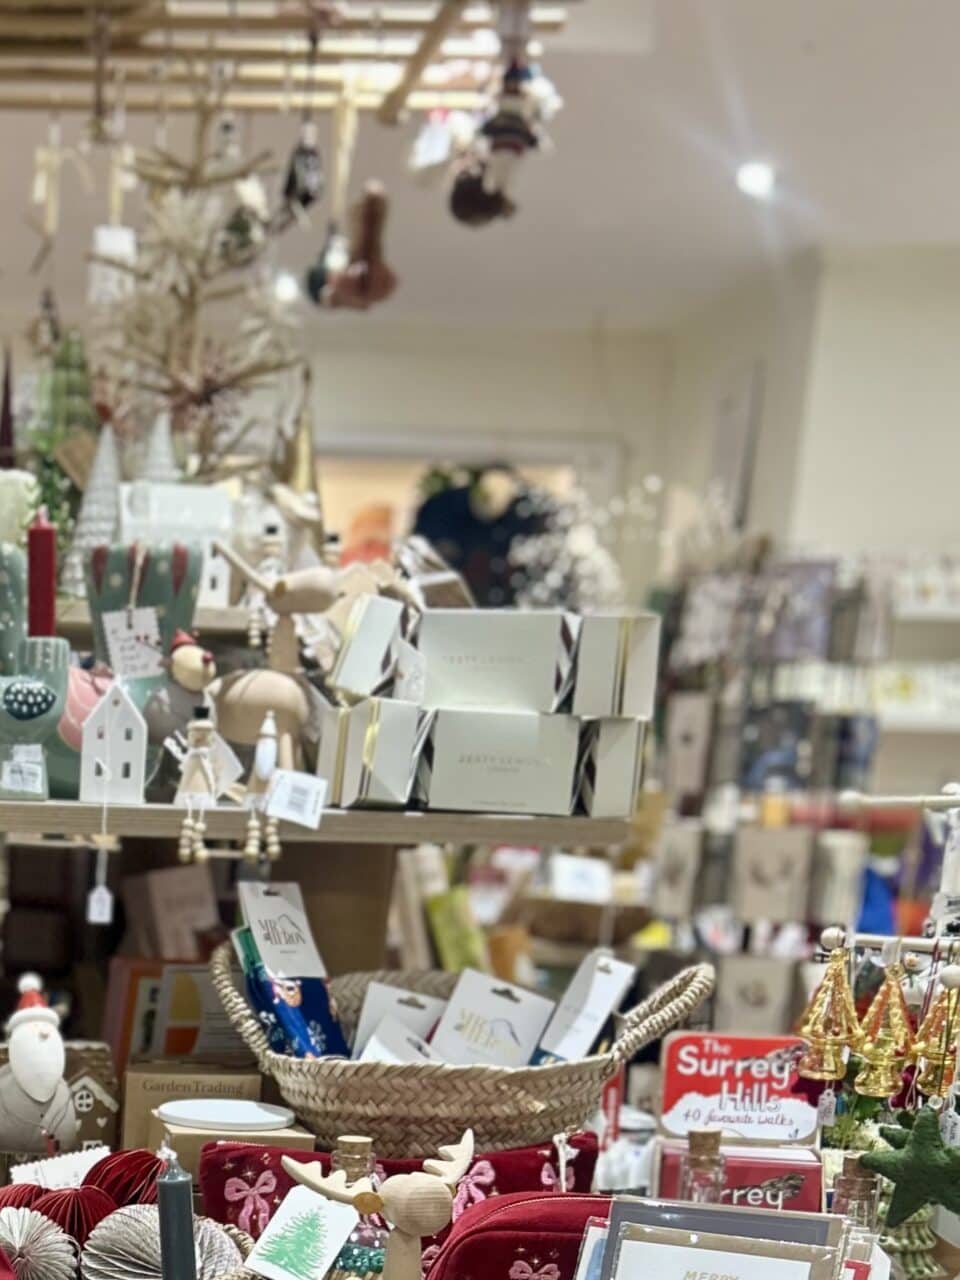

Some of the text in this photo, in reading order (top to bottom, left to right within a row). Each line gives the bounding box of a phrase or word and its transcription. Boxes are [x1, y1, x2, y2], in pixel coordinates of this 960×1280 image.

[702, 1038, 732, 1055] The
[676, 1044, 791, 1091] Surrey
[143, 1081, 244, 1096] Garden Trading
[718, 1080, 781, 1115] Hills
[682, 1108, 701, 1122] 40
